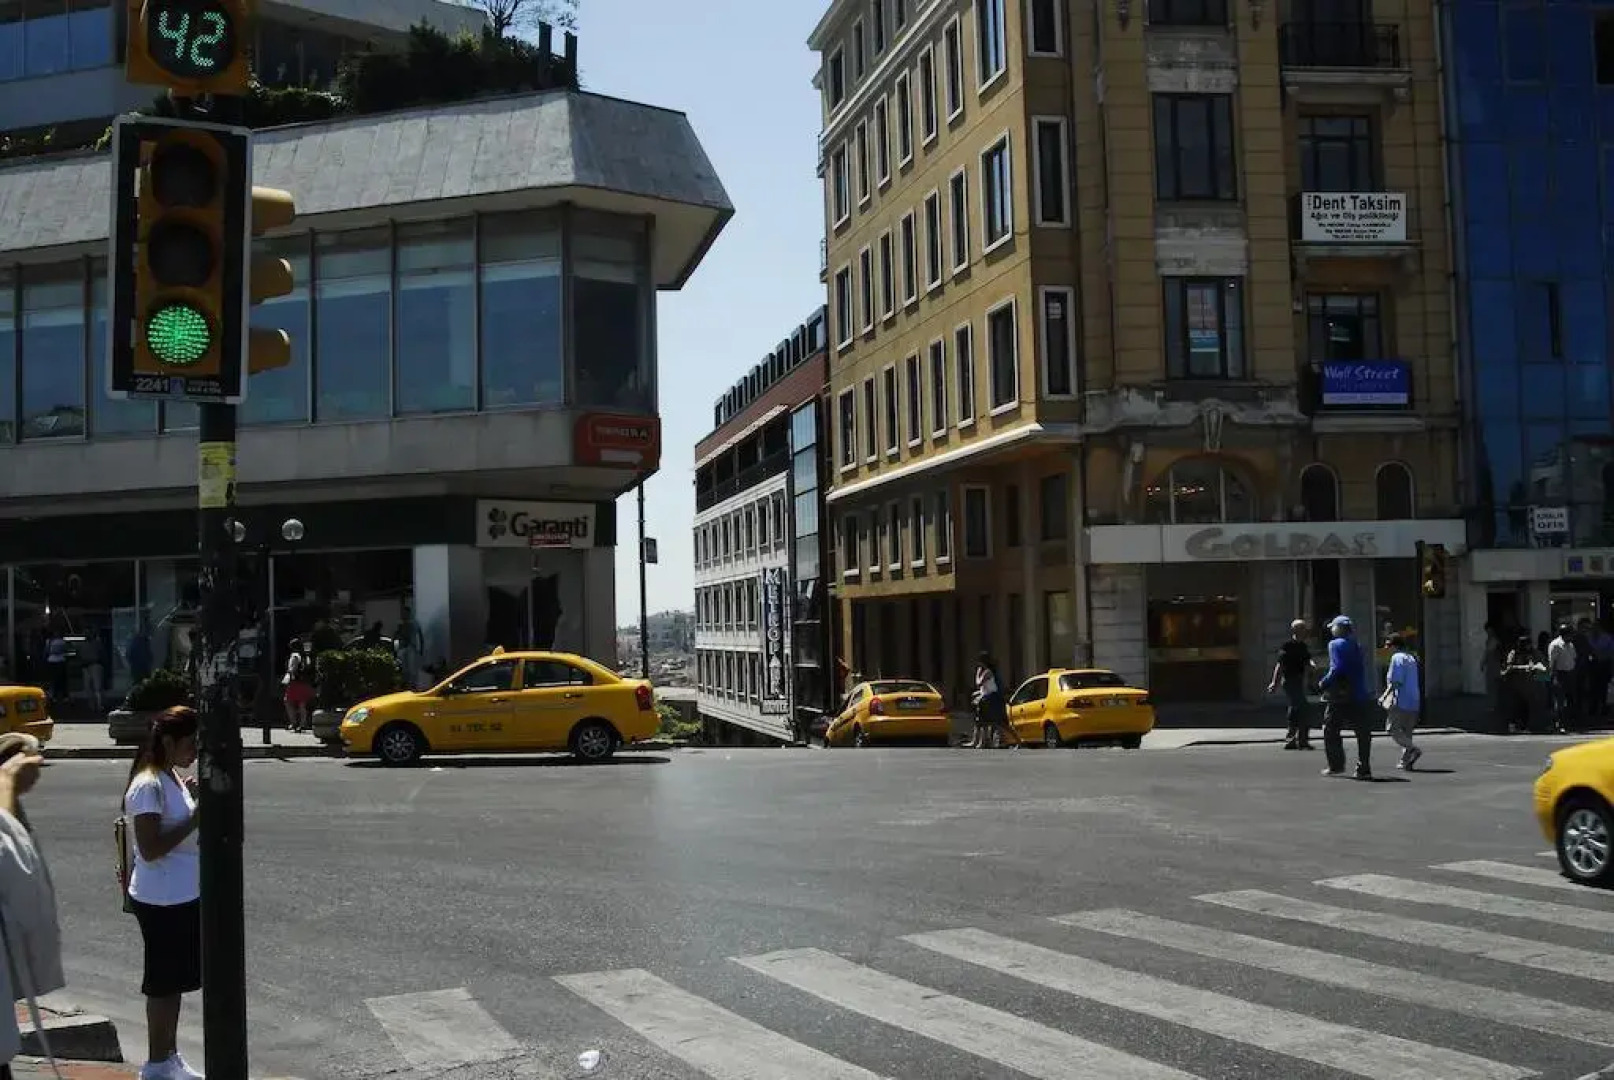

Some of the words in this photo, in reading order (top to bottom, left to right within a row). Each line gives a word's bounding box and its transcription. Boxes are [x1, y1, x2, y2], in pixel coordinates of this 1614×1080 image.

[158, 11, 227, 67] 42
[1313, 195, 1347, 210] Dent
[1351, 195, 1401, 211] Taksim
[1354, 365, 1402, 381] Street
[136, 378, 170, 392] 2241
[511, 512, 589, 538] Garanti
